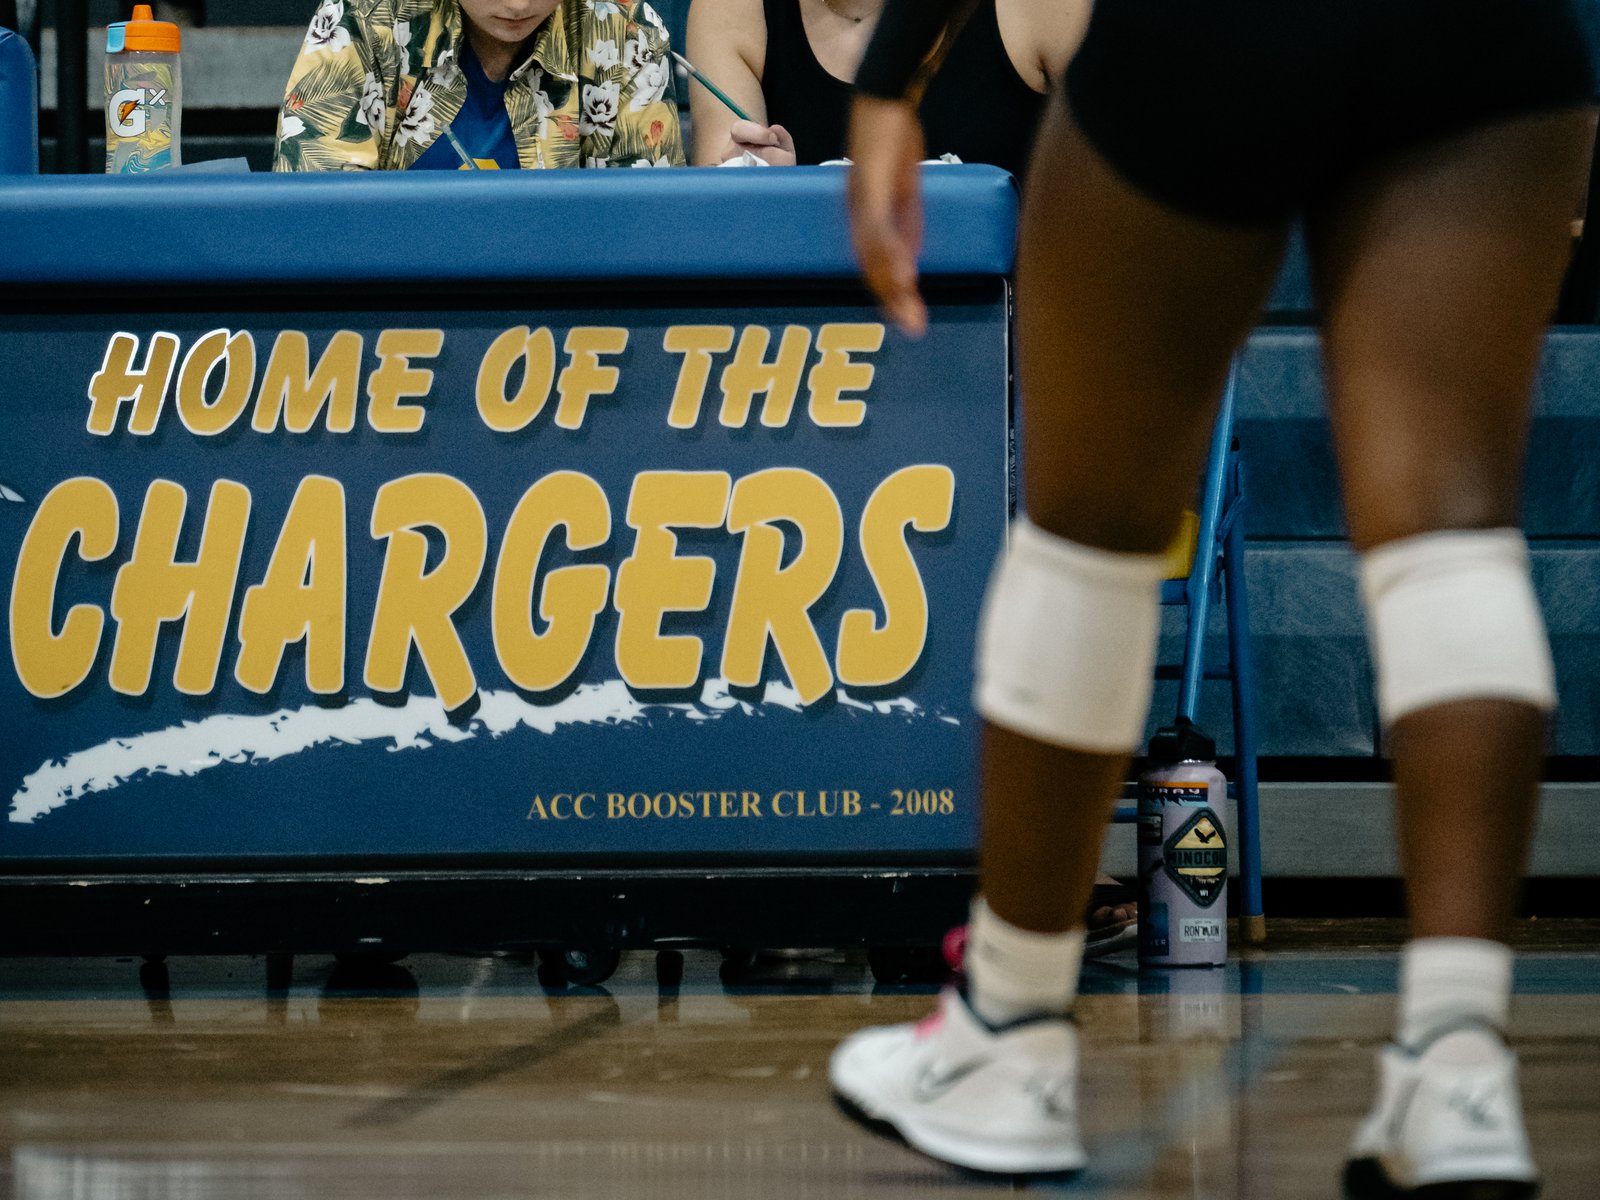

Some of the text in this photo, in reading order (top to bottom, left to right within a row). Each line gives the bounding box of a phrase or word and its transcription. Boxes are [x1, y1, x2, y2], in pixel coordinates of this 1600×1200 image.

[86, 322, 885, 436] HOME OF THE
[9, 464, 956, 712] CHARGERS
[526, 793, 596, 820] ACC
[606, 790, 763, 819] BOOSTER
[771, 789, 862, 817] CLUB
[889, 788, 955, 816] 2008
[1184, 925, 1200, 937] RON
